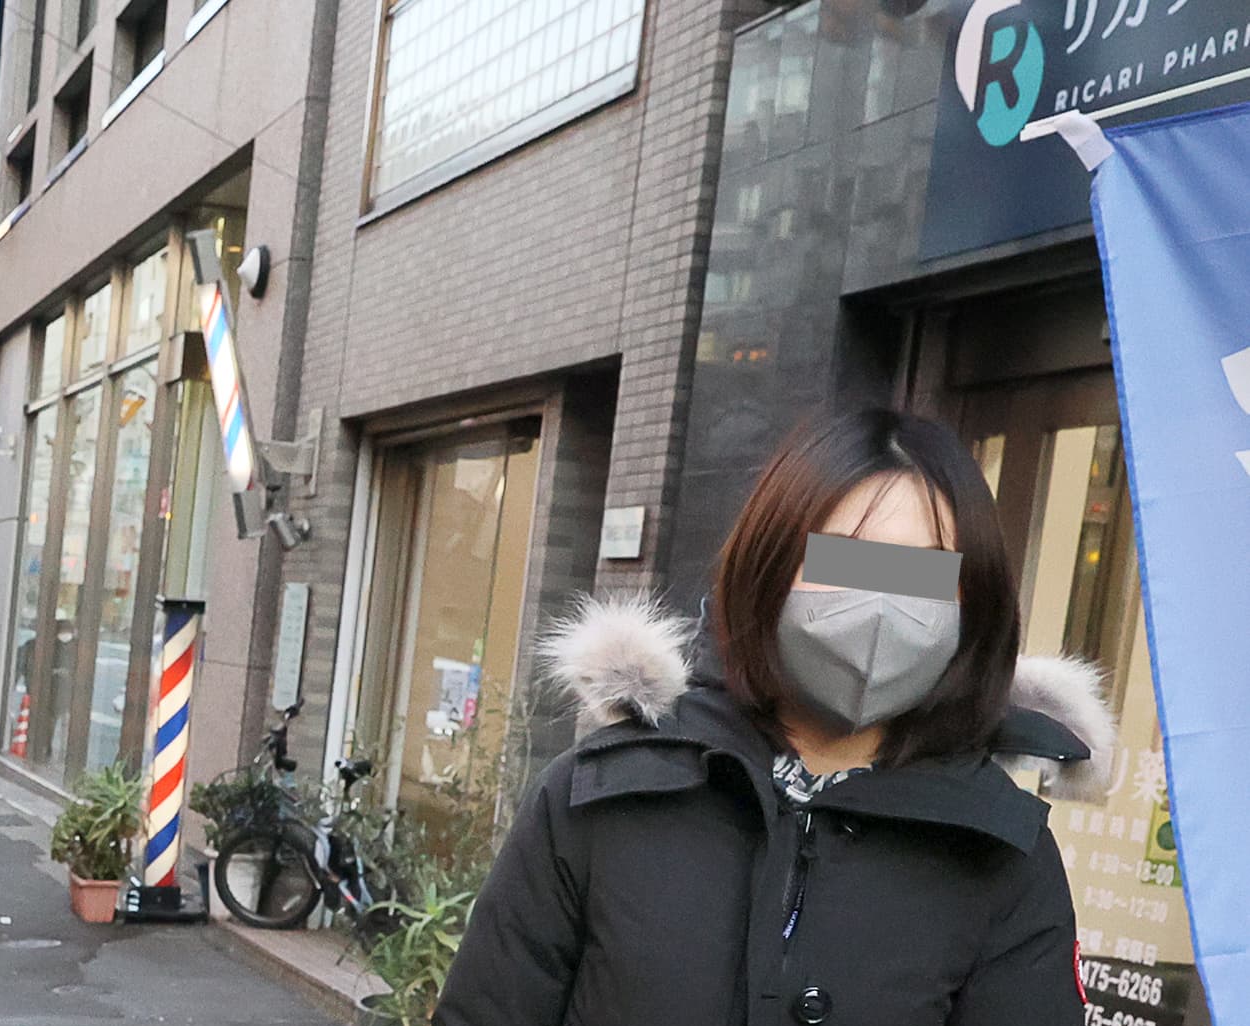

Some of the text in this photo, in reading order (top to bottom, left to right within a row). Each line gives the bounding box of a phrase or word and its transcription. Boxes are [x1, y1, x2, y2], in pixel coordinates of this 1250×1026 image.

[1064, 0, 1188, 54] リカ
[1054, 23, 1250, 112] RICARI PHAR
